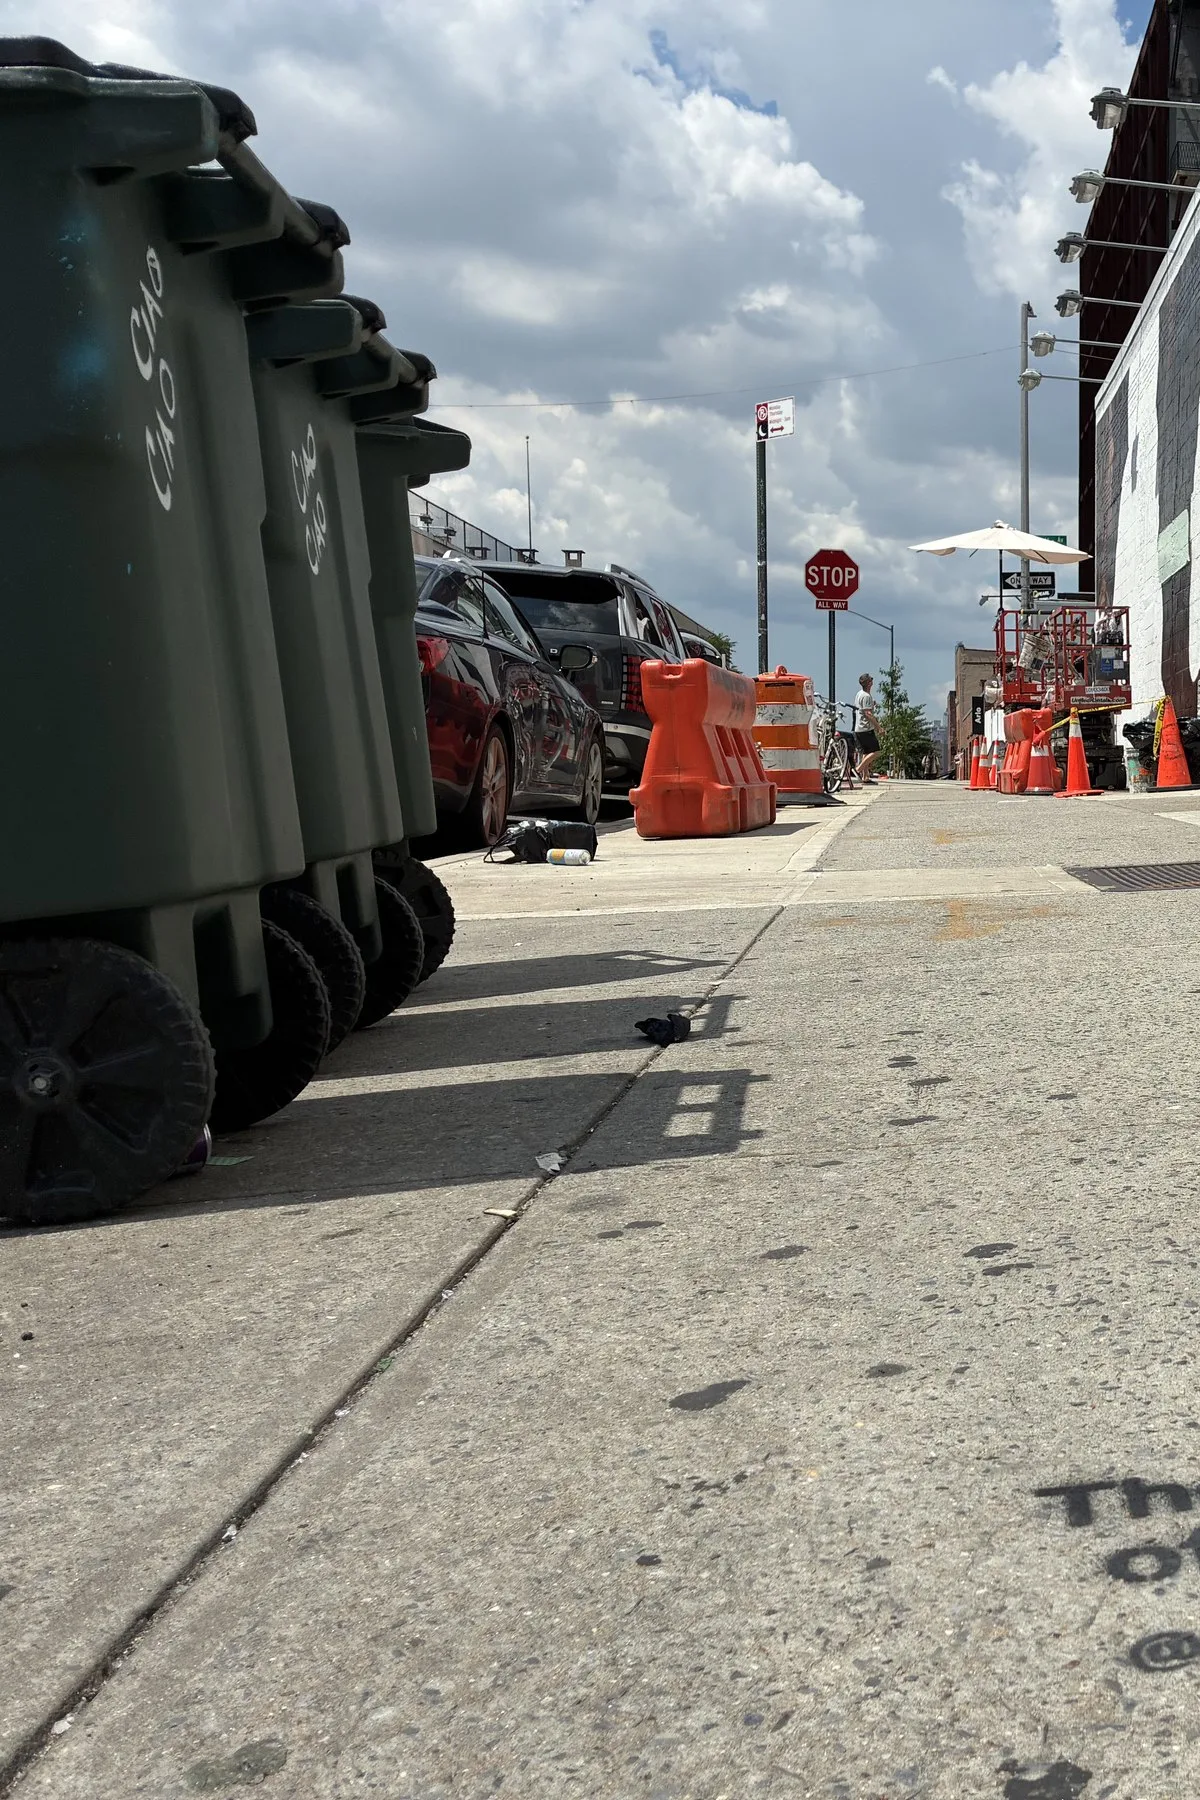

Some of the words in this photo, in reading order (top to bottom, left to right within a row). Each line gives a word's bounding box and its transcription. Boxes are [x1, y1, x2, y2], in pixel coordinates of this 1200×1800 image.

[130, 245, 163, 381] CIAO
[145, 358, 176, 512] CIAO
[807, 565, 857, 587] STOP
[974, 707, 982, 724] Arlo
